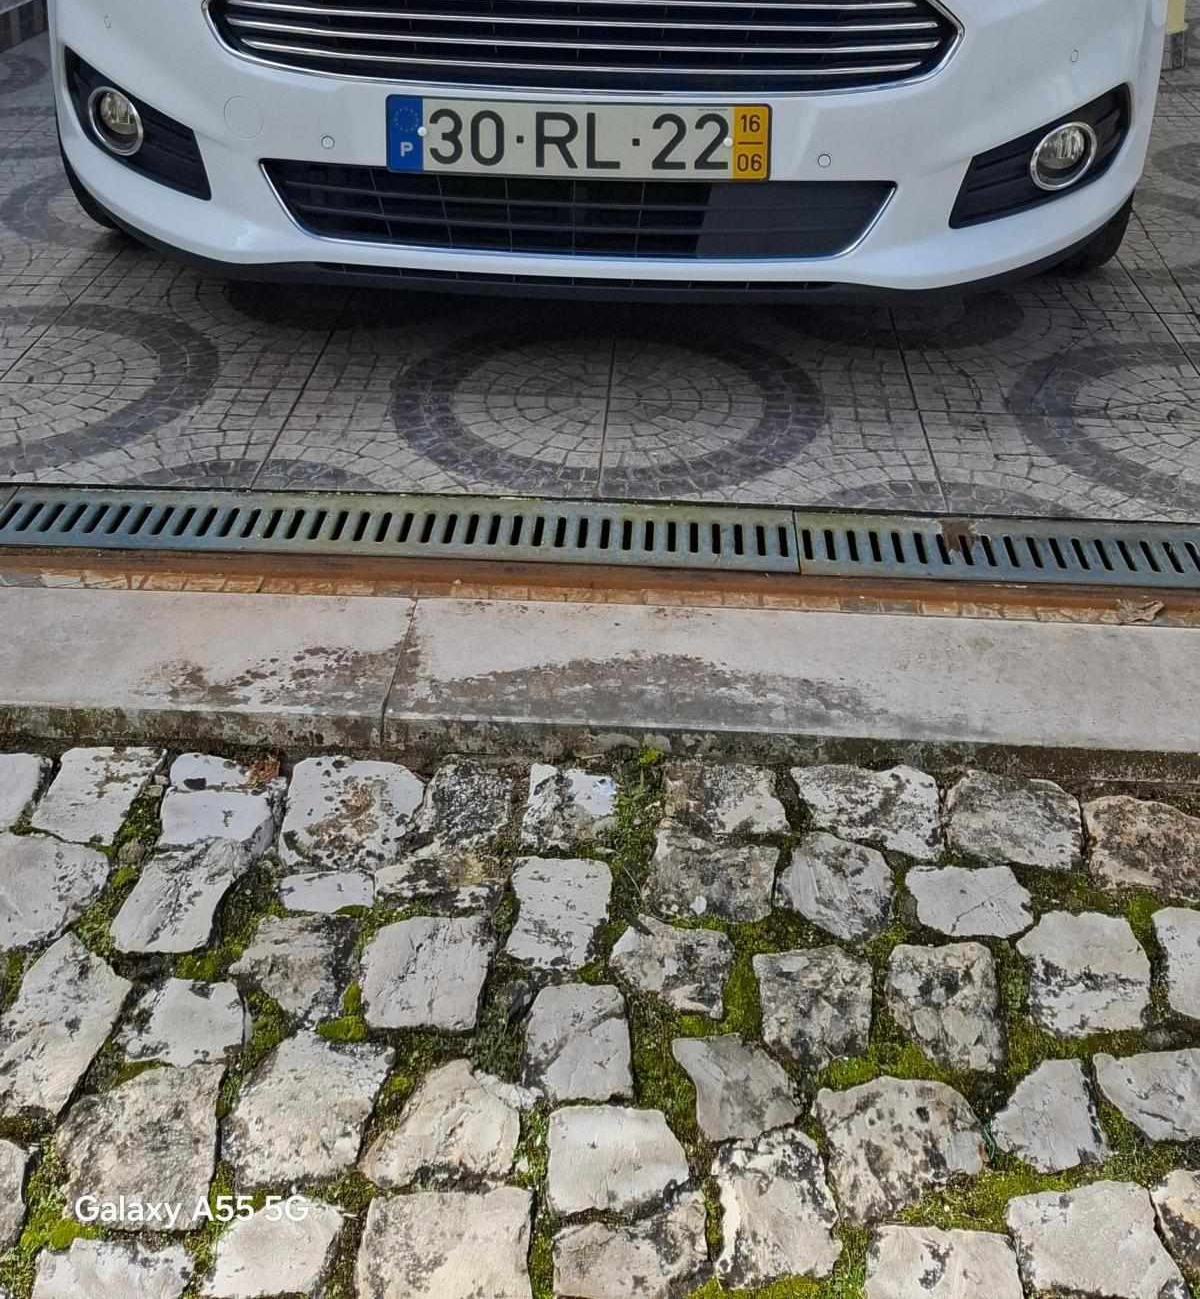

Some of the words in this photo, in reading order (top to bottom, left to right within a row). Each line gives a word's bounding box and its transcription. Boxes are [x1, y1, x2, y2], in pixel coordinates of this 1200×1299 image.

[740, 114, 760, 133] 16
[400, 141, 414, 157] P
[737, 153, 762, 172] 06
